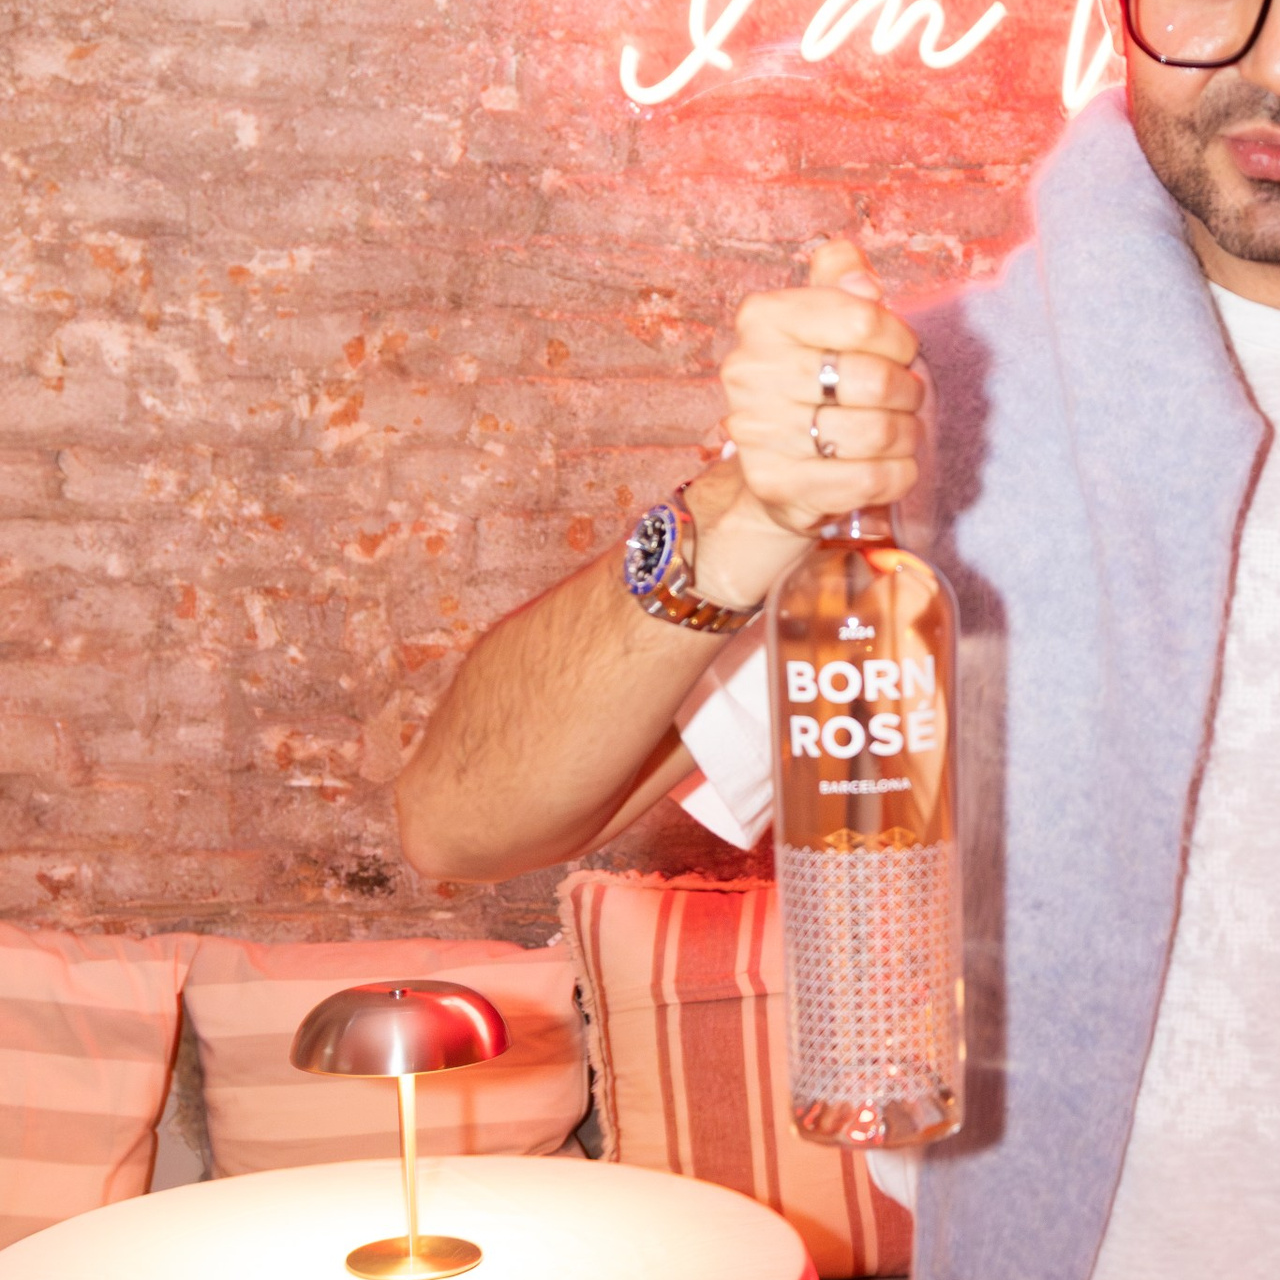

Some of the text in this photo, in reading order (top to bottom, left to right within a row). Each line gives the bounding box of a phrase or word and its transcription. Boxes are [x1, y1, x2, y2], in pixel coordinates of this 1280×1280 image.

[786, 654, 936, 705] BORN
[789, 699, 938, 760] ROSÉ
[818, 777, 912, 795] BARCELONA
